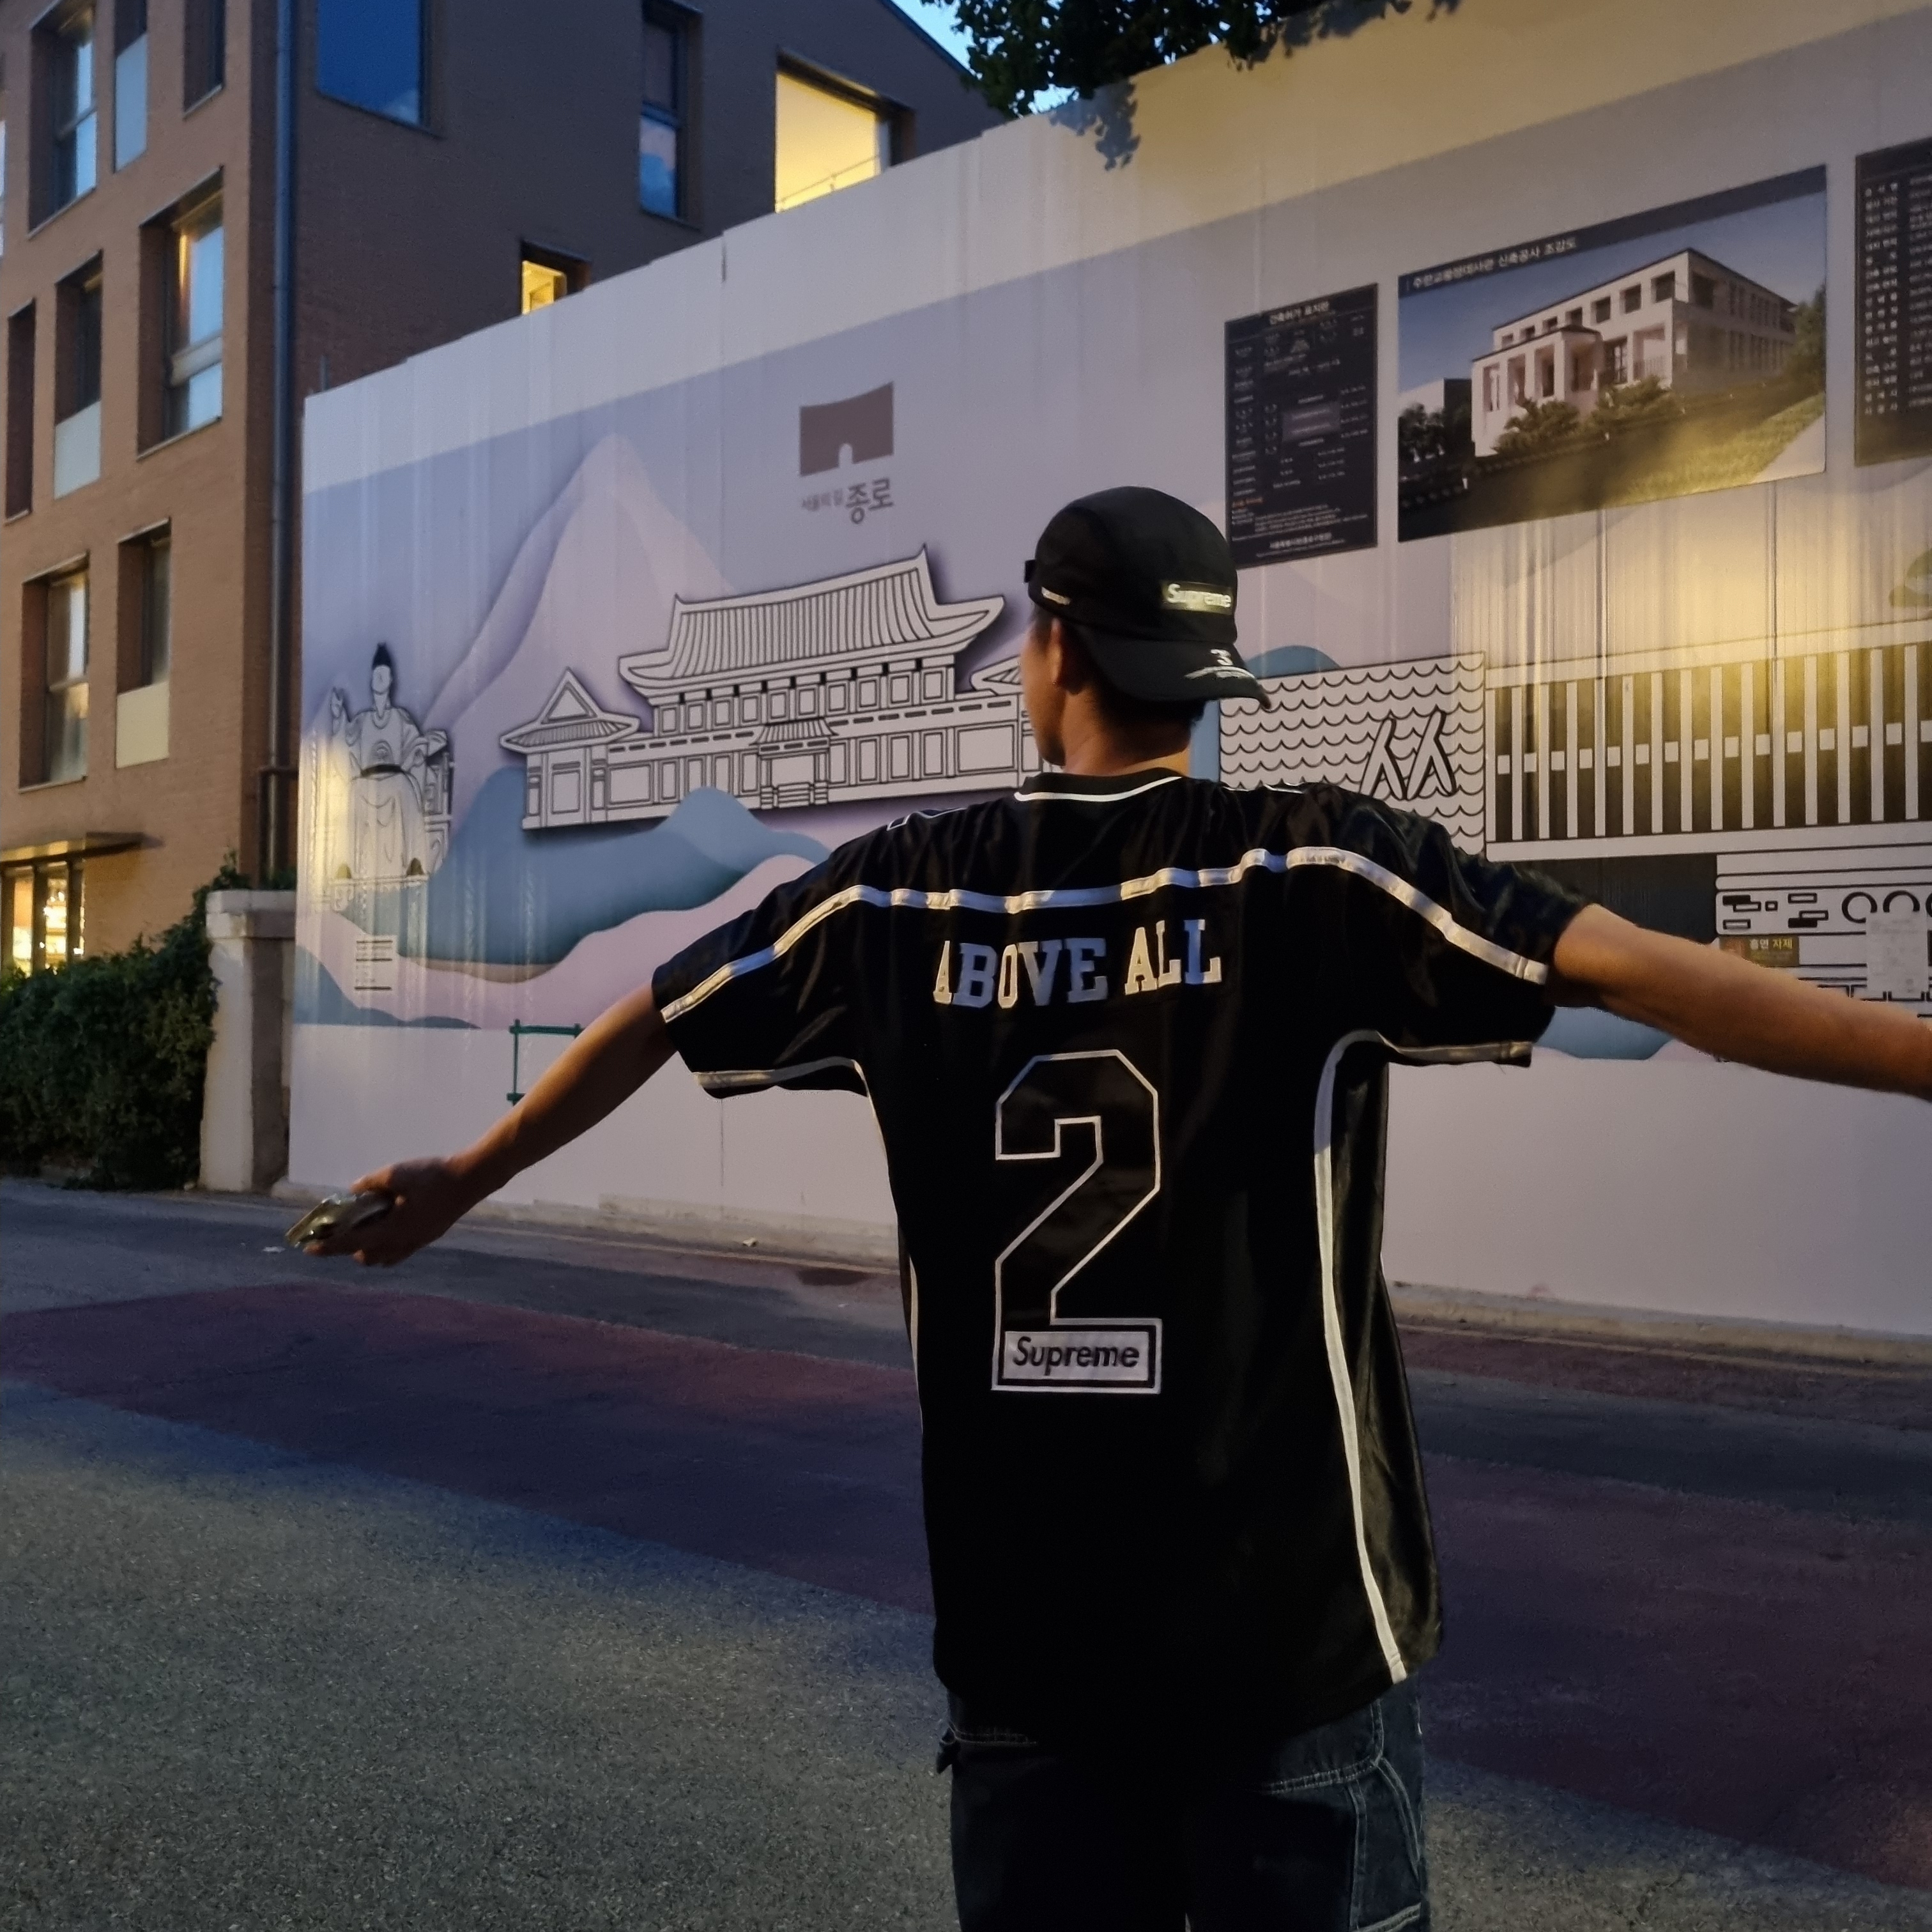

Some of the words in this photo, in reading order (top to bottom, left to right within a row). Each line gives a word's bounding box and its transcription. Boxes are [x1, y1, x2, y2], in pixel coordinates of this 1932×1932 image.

[845, 477, 894, 525] 종로
[933, 937, 1108, 1009] ABOVE
[1124, 919, 1223, 995] ALL
[991, 1048, 1163, 1395] 2
[1012, 1335, 1140, 1376] Supreme
